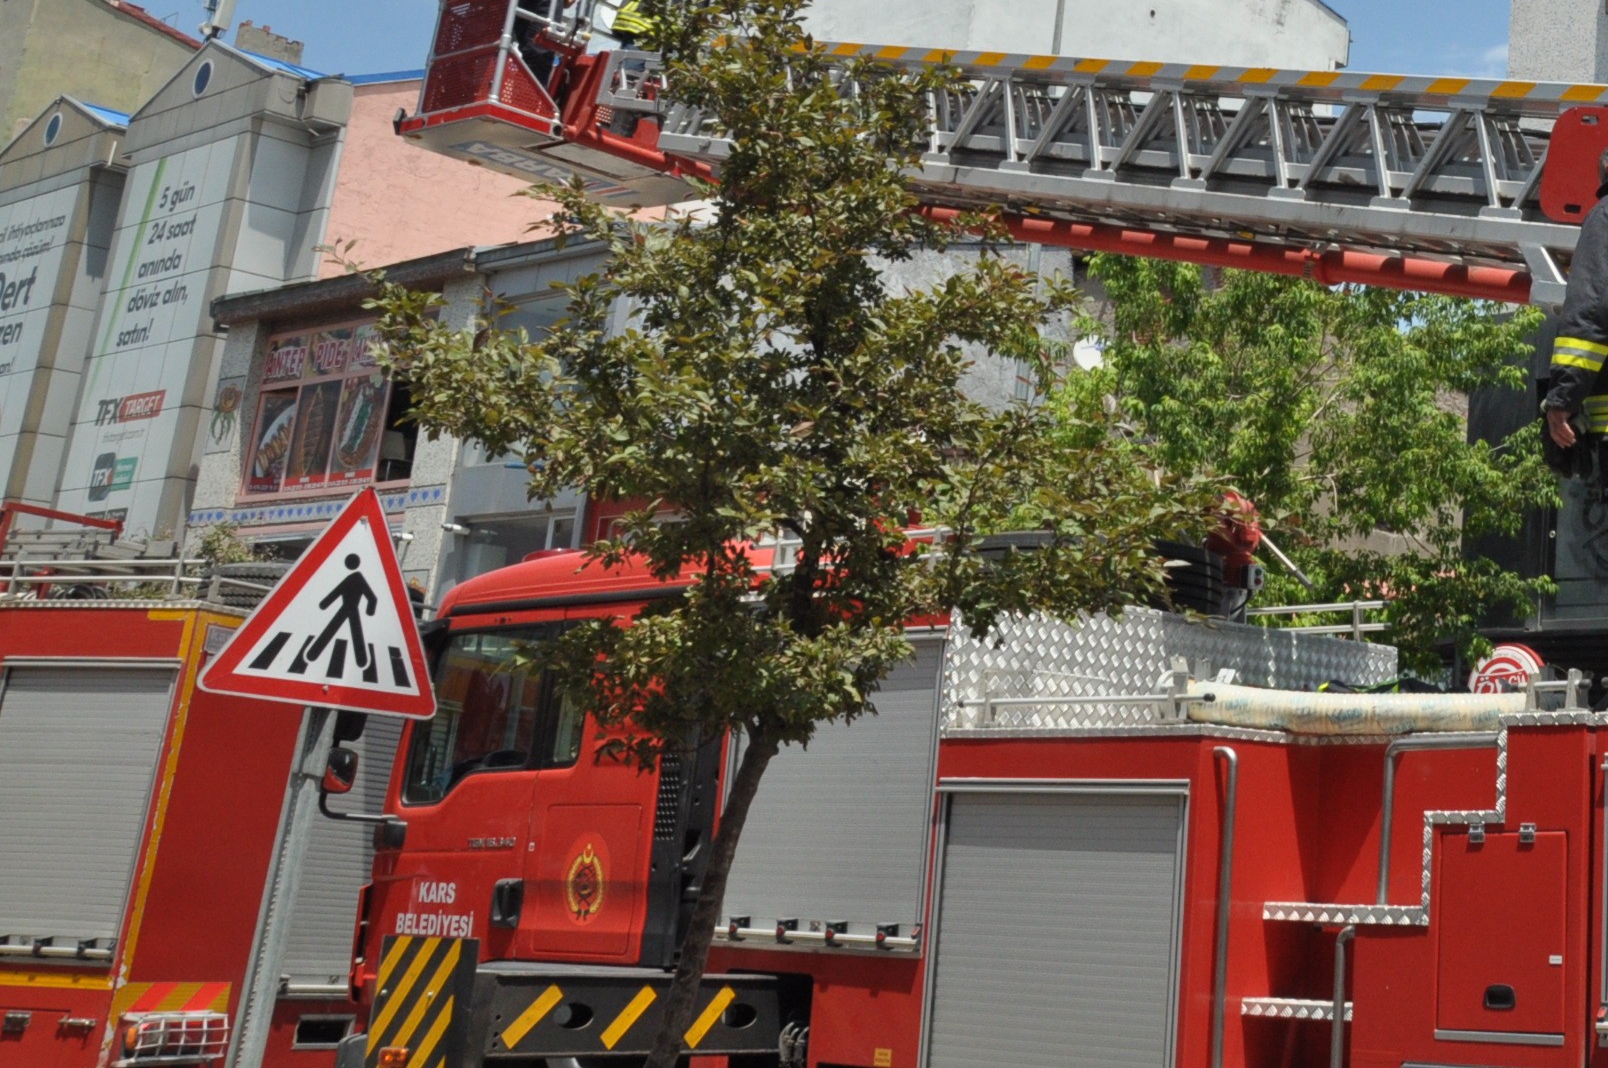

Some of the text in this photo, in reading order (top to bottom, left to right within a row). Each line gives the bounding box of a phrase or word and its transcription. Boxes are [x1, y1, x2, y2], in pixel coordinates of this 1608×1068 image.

[159, 180, 195, 212] 5 gün
[148, 211, 198, 245] 24 saat
[138, 248, 182, 279] anında
[127, 280, 189, 313] döviz alın,
[116, 317, 154, 347] satın!
[95, 395, 161, 426] TFX TARGET
[418, 881, 456, 904] KARS
[395, 908, 474, 938] BELEDİYESİ
